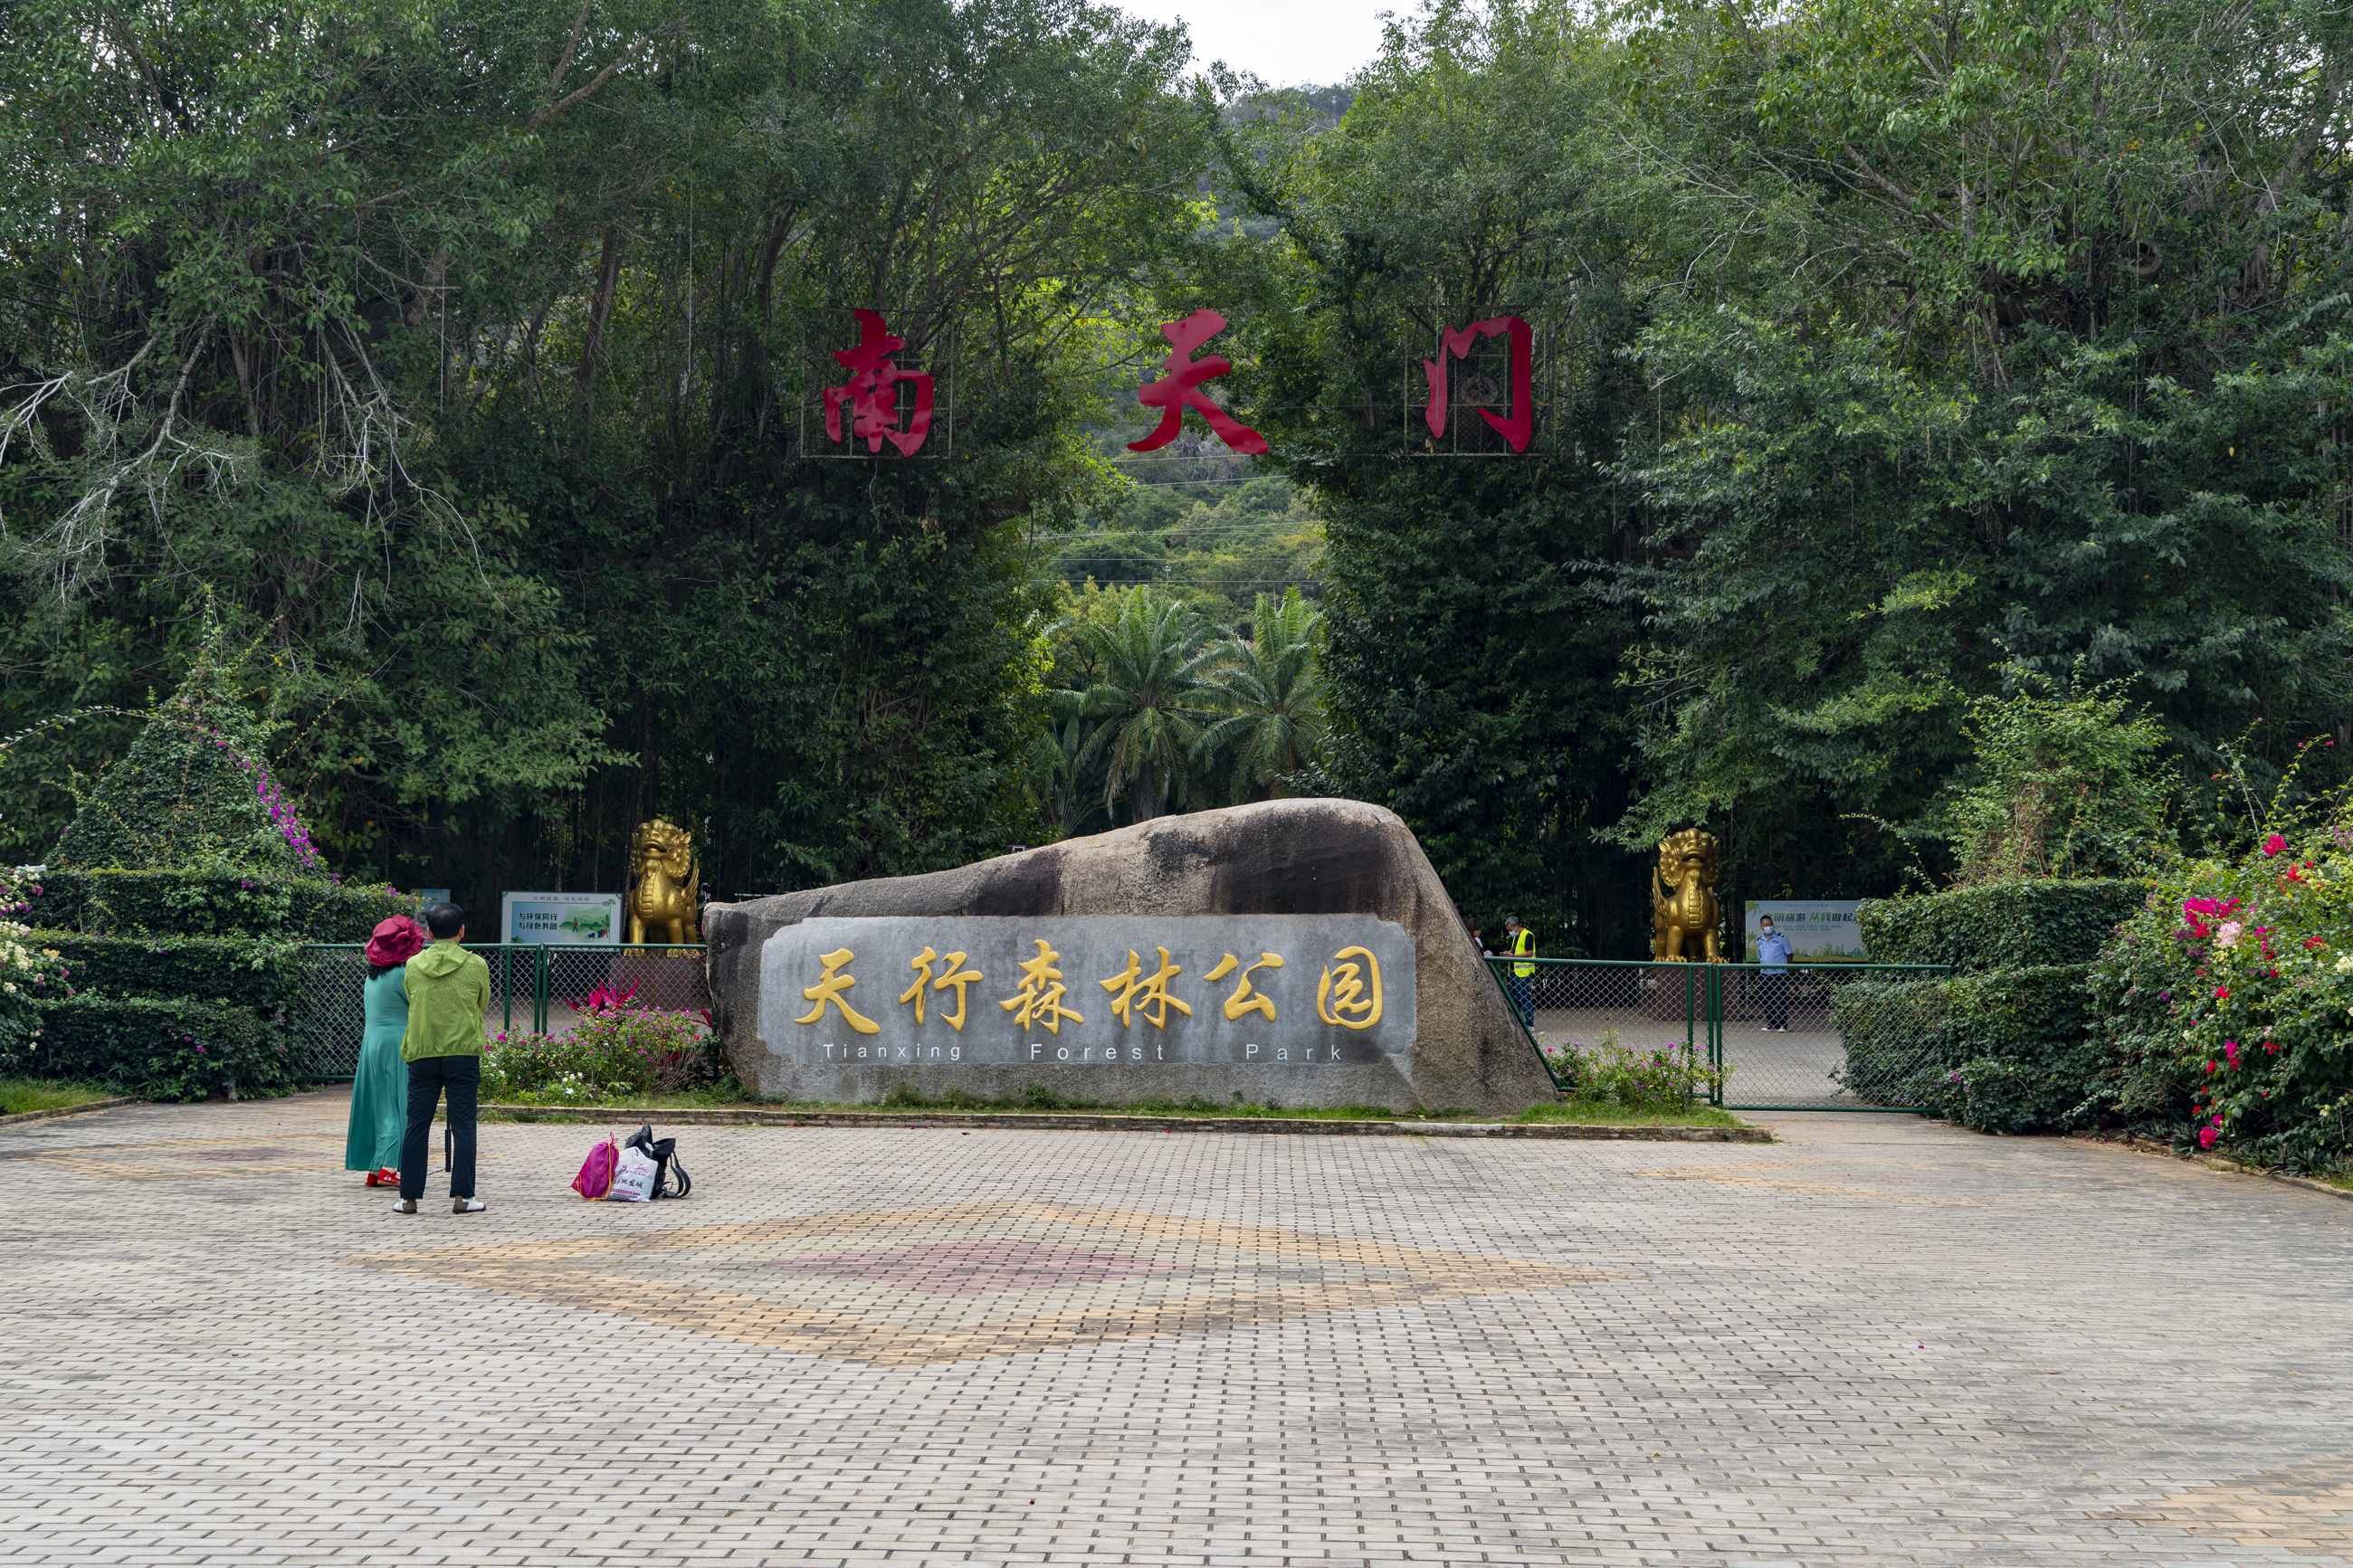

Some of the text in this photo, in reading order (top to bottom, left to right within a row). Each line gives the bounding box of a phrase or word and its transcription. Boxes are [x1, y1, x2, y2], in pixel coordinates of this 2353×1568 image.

[823, 309, 1532, 457] 南天门
[519, 912, 558, 921] 与环保同行
[1809, 912, 1853, 922] 从我做起
[518, 922, 557, 930] 与绿色共融
[794, 939, 1384, 1035] 天行森林公园
[823, 1043, 1341, 1061] Tianxing Forest Park
